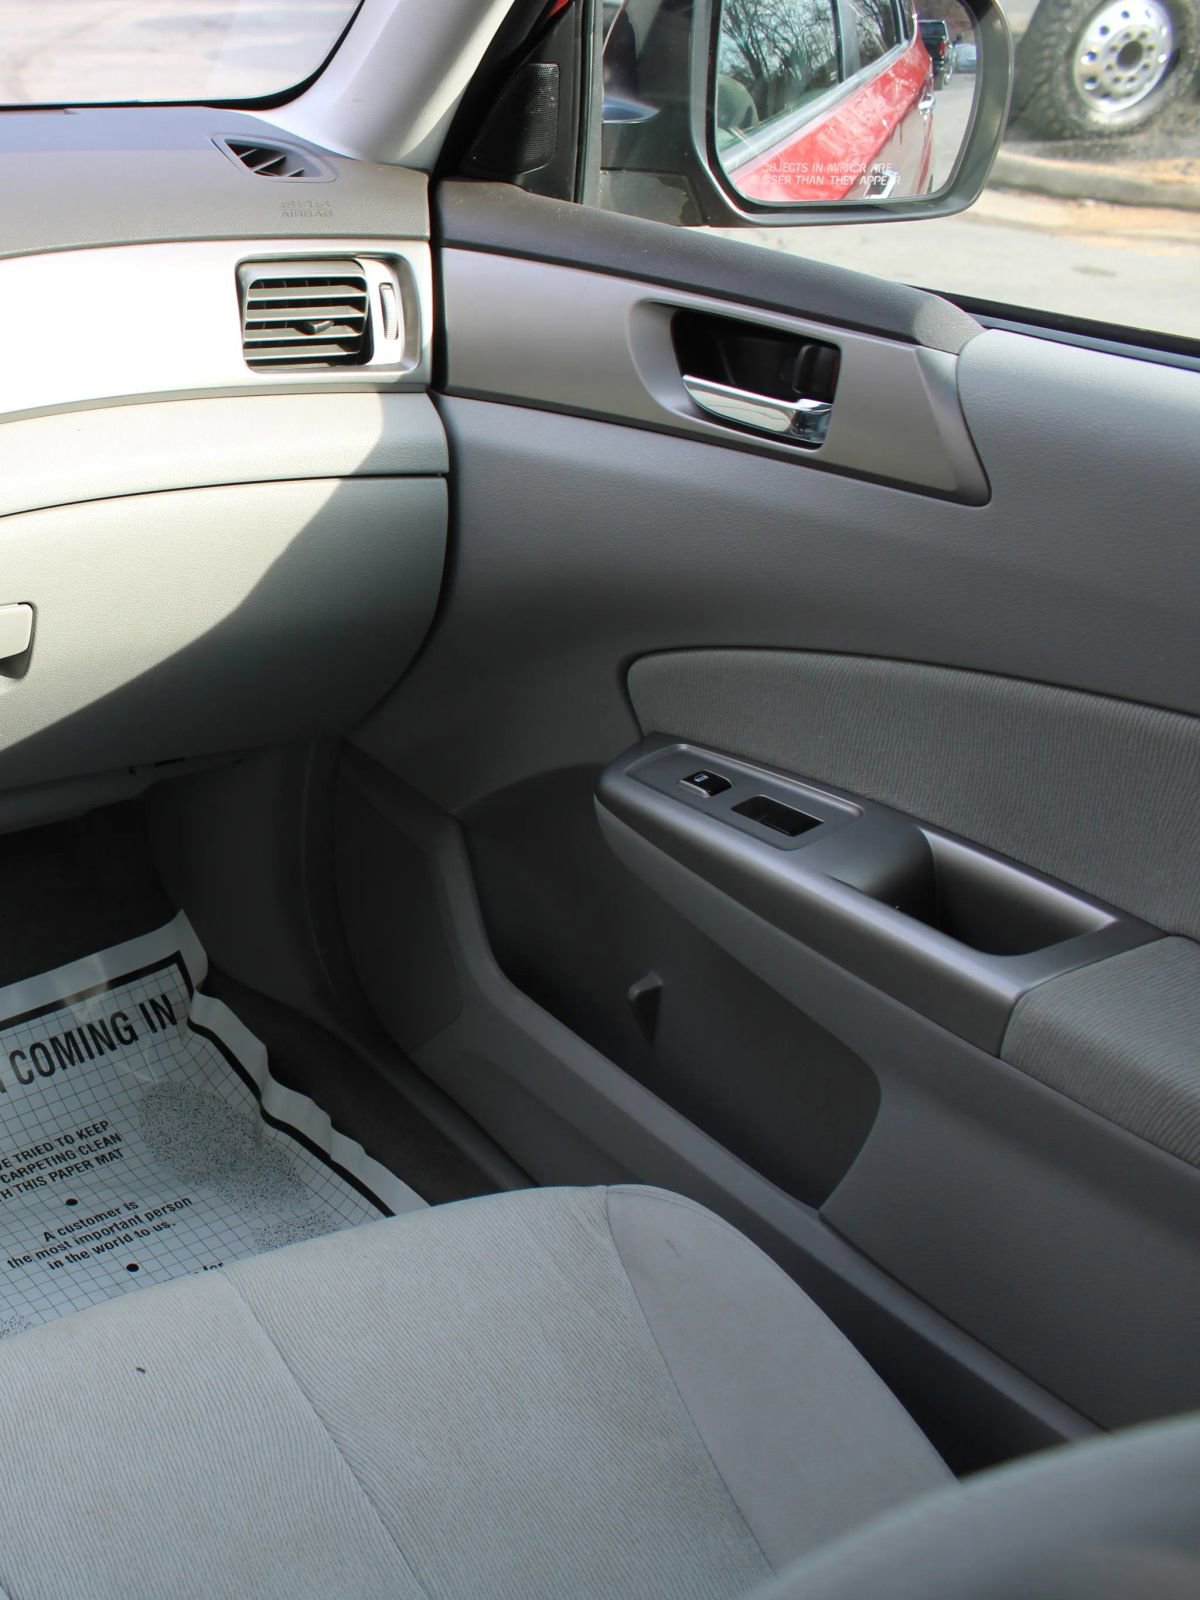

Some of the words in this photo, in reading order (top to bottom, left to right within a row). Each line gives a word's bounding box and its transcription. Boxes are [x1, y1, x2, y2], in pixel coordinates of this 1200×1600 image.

[762, 162, 809, 173] OBJECTS
[812, 162, 824, 173] IN
[827, 162, 867, 174] MIRROR
[870, 162, 894, 173] ARE
[796, 175, 824, 186] THAN
[830, 175, 856, 186] THEY
[9, 1010, 139, 1086] COMING
[138, 993, 178, 1034] IN
[0, 1150, 76, 1184] CARPETING
[78, 1132, 122, 1155] CLEAN
[13, 1142, 54, 1164] TRIED
[55, 1134, 75, 1148] TO
[76, 1120, 110, 1140] KEEP
[13, 1176, 47, 1194] THIS
[49, 1160, 93, 1182] PAPER
[95, 1148, 125, 1166] MAT
[7, 1254, 32, 1269] the
[36, 1241, 72, 1260] most
[74, 1215, 144, 1246] important
[144, 1197, 193, 1222] person
[43, 1231, 55, 1242] A
[57, 1207, 122, 1237] customer
[47, 1258, 64, 1270] in
[65, 1250, 90, 1264] the
[92, 1233, 134, 1254] world
[134, 1227, 150, 1238] to
[152, 1220, 176, 1232] us.
